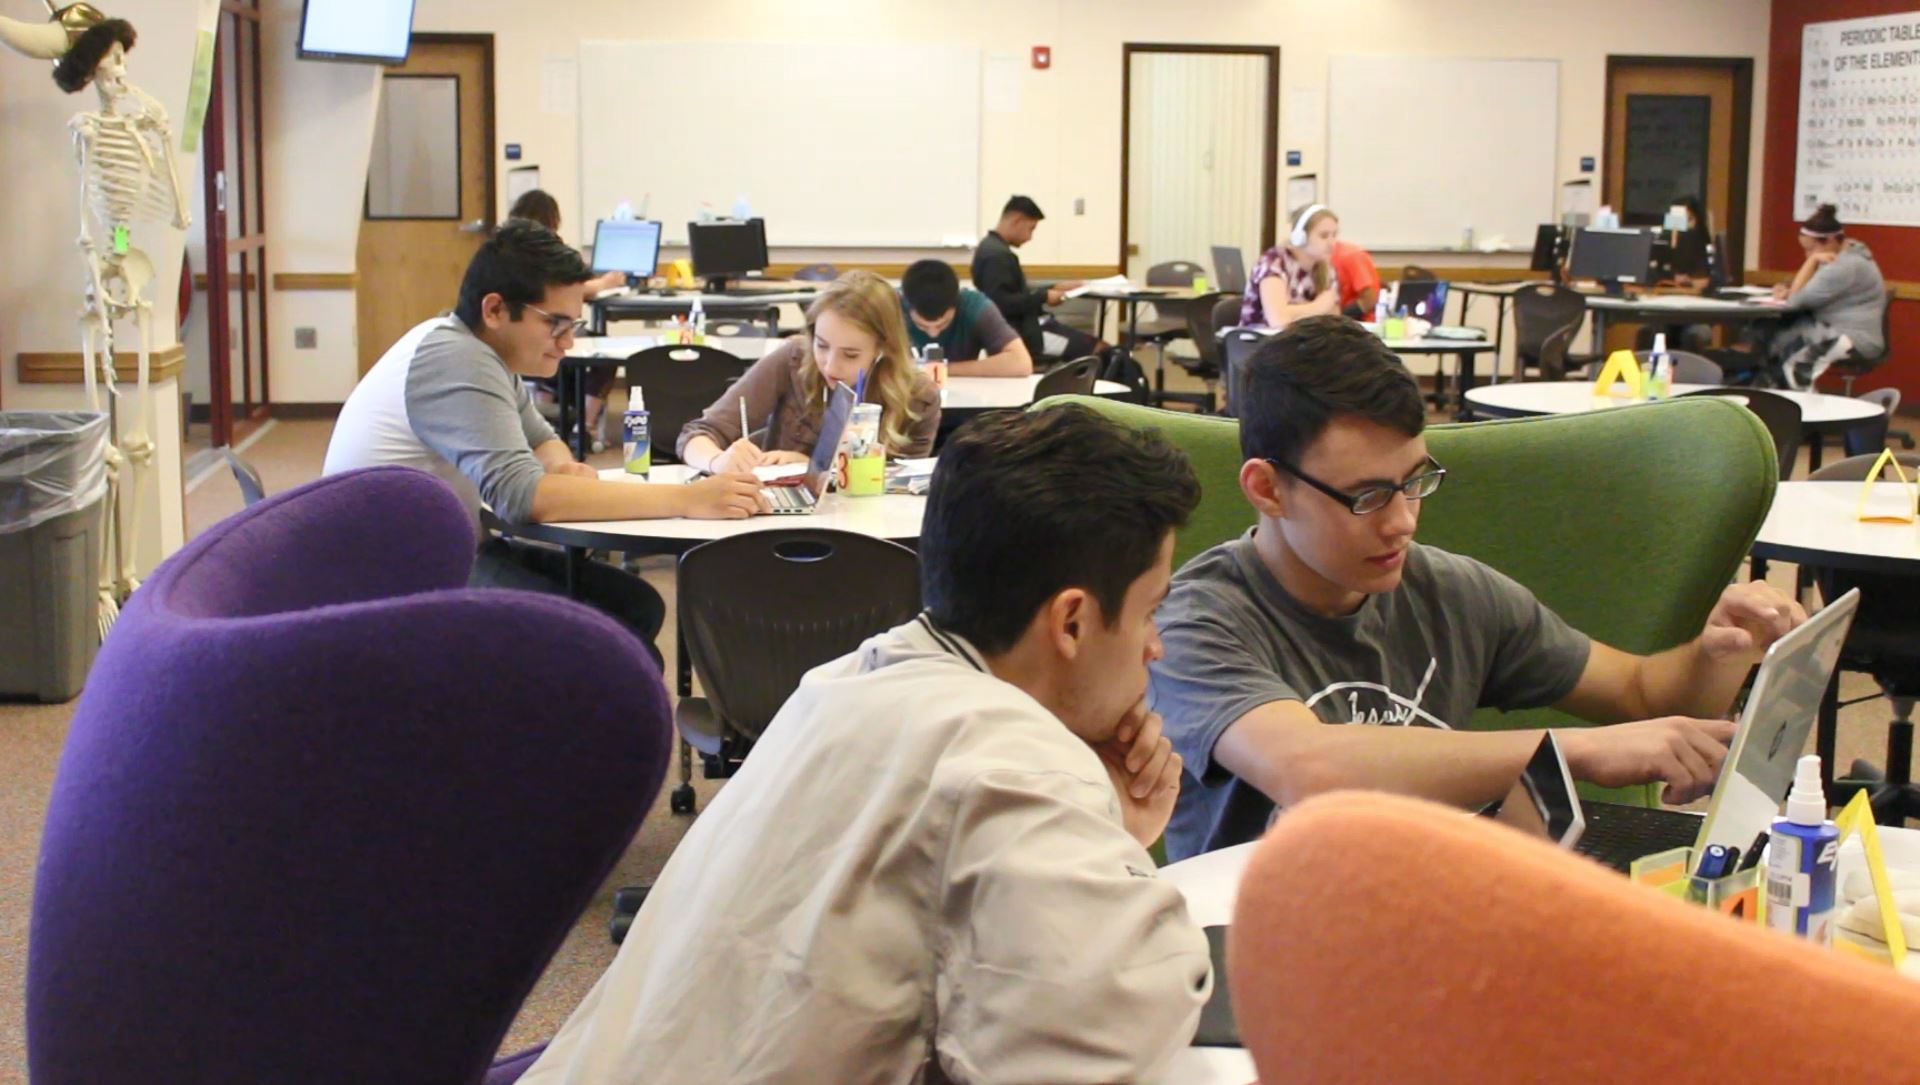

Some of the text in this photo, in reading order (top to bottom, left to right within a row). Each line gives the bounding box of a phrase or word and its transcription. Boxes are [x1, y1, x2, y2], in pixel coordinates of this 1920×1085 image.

[1840, 25, 1920, 46] PERIODIC TABLE
[1834, 50, 1920, 72] OF THE ELEMENT
[838, 451, 849, 489] 3
